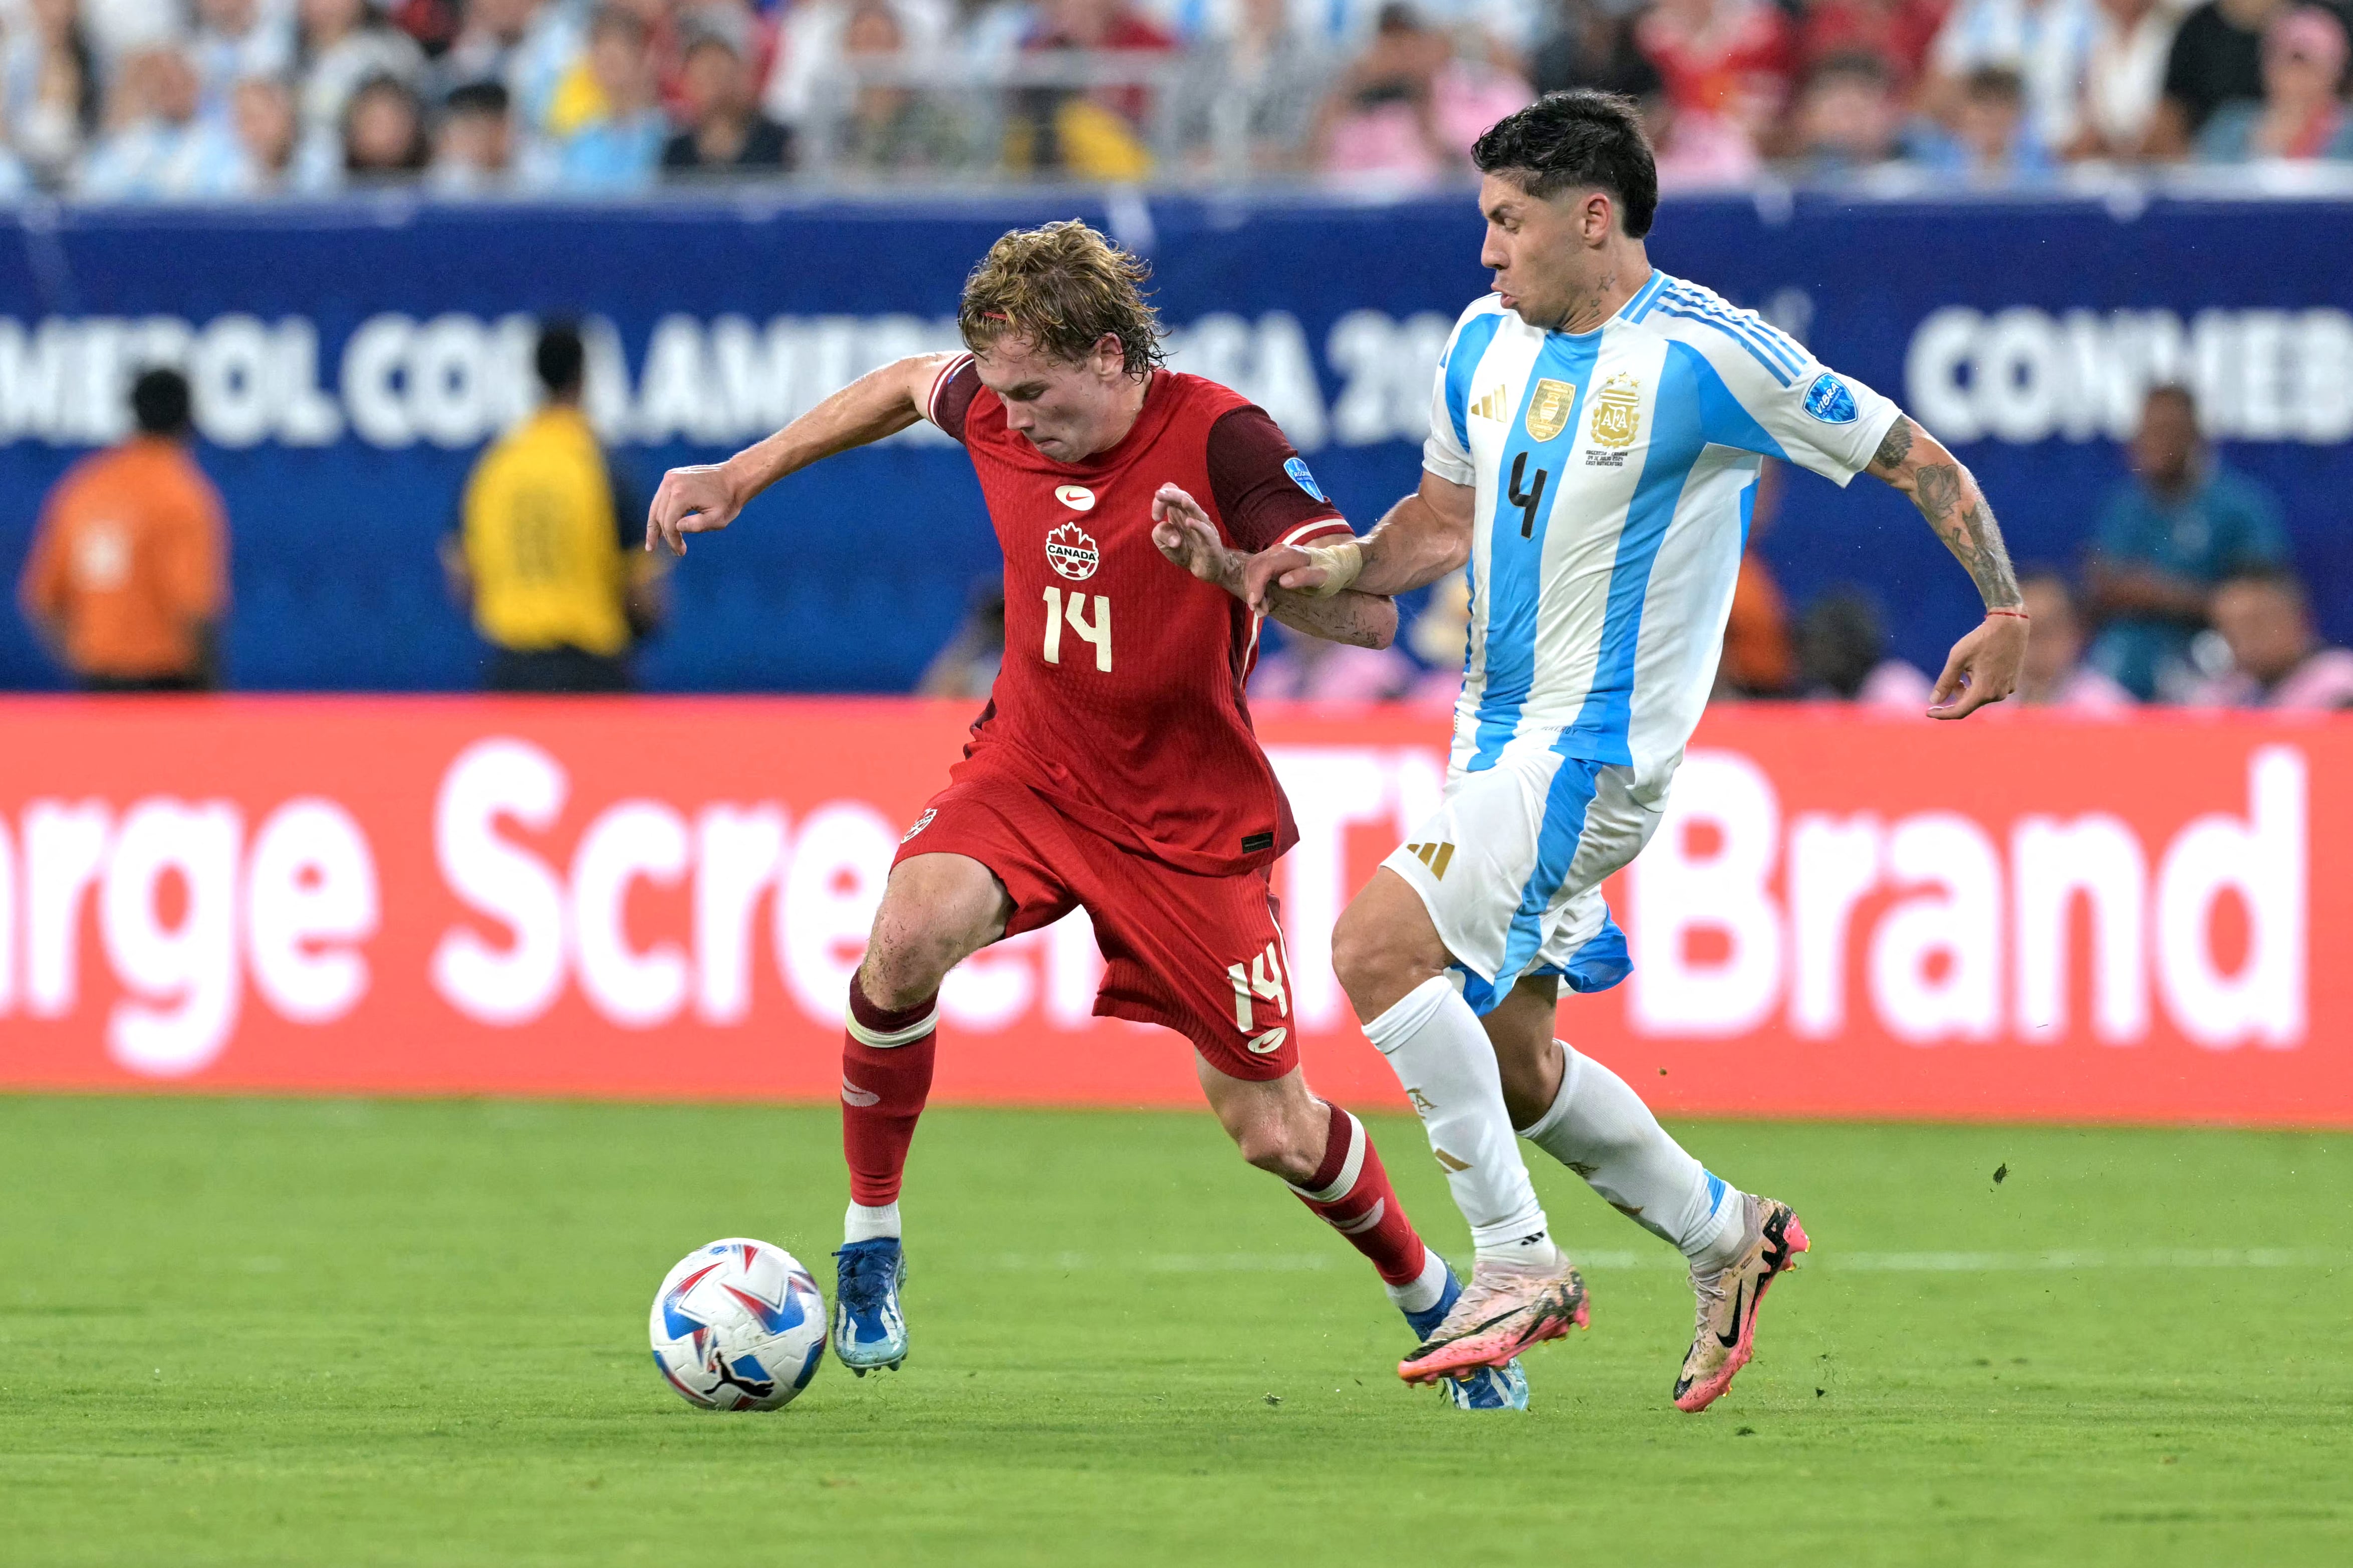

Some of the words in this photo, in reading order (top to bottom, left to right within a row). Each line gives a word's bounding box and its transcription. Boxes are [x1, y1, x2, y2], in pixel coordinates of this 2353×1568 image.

[1601, 404, 1628, 432] AFA
[1815, 382, 1840, 414] VIBRA
[1508, 451, 1548, 539] 4
[1048, 544, 1096, 561] CANADA
[1042, 586, 1112, 672] 14
[0, 795, 380, 1074] rge
[1627, 744, 2307, 1049] Brand
[1227, 942, 1288, 1033] 14
